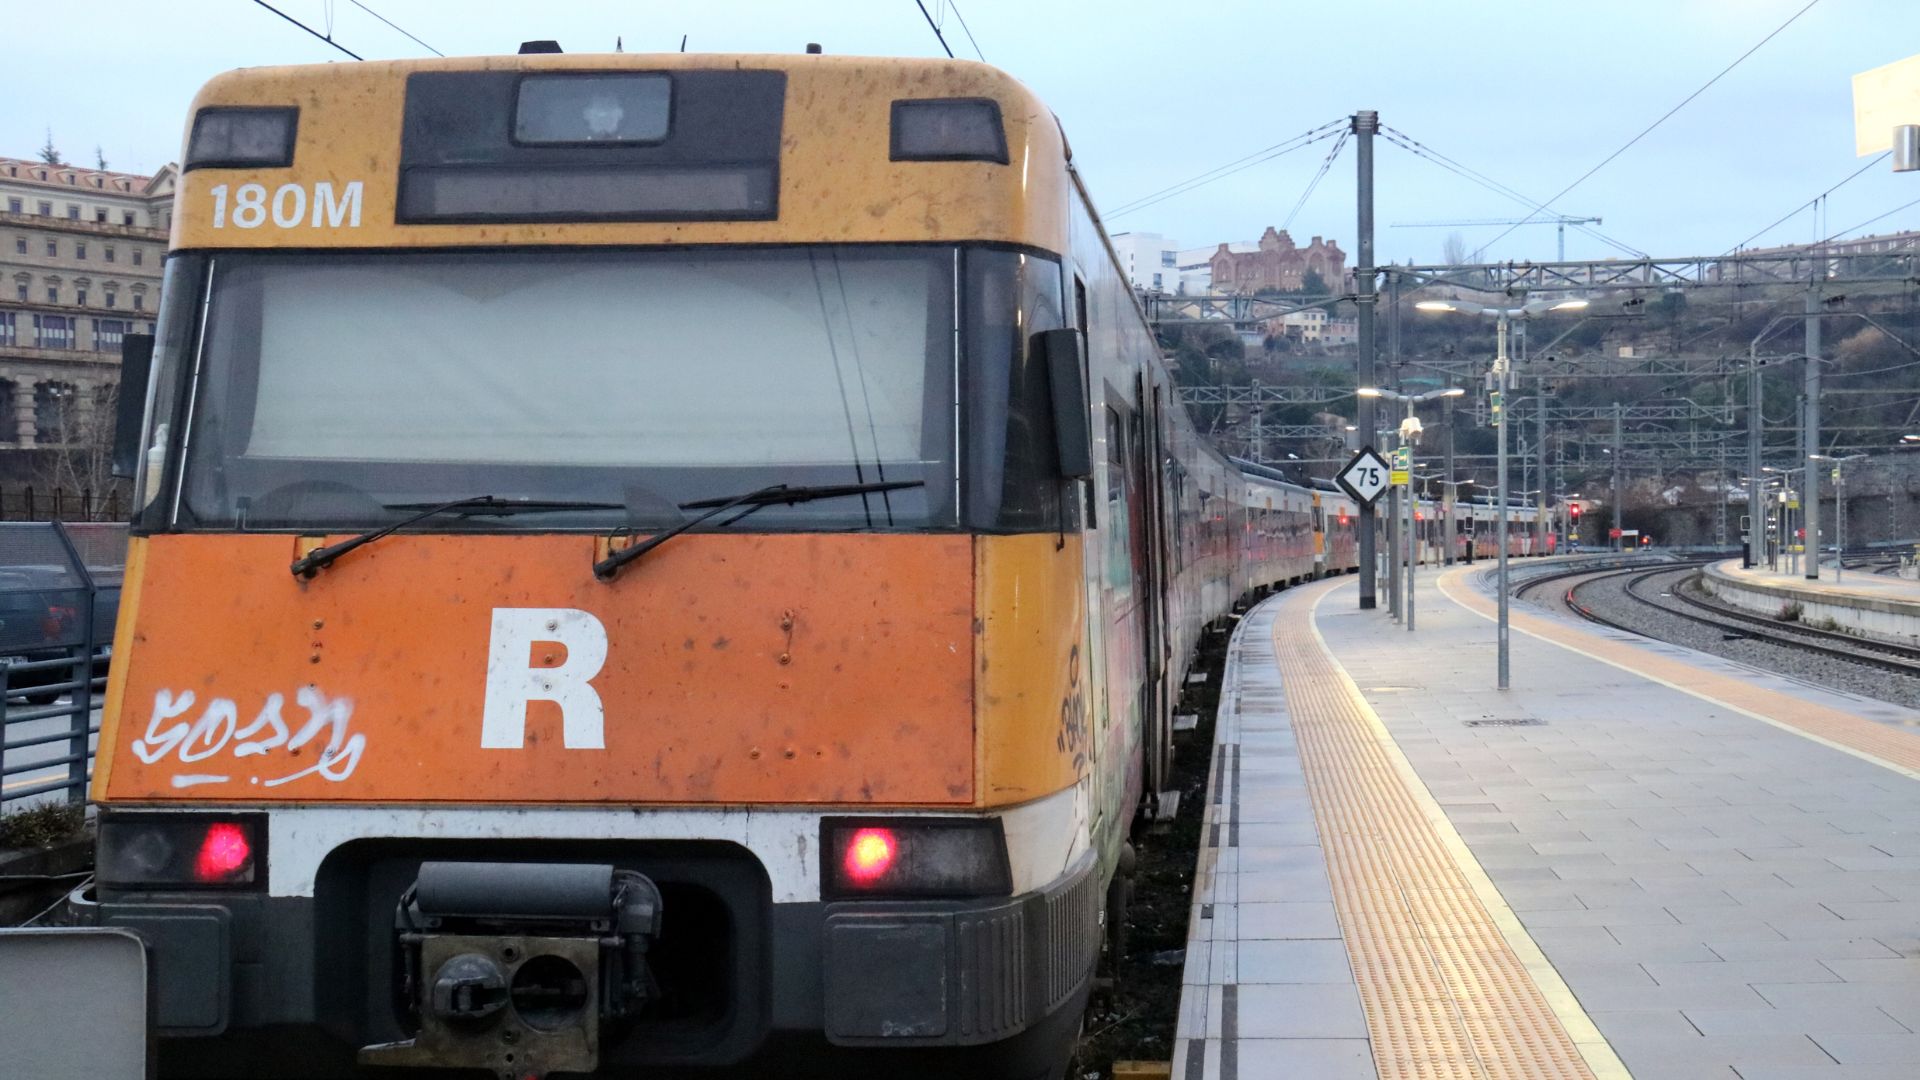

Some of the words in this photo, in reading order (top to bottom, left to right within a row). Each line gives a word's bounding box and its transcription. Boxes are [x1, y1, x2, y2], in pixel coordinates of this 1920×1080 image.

[211, 181, 364, 229] 180M
[1357, 467, 1379, 487] 75
[480, 607, 608, 749] R
